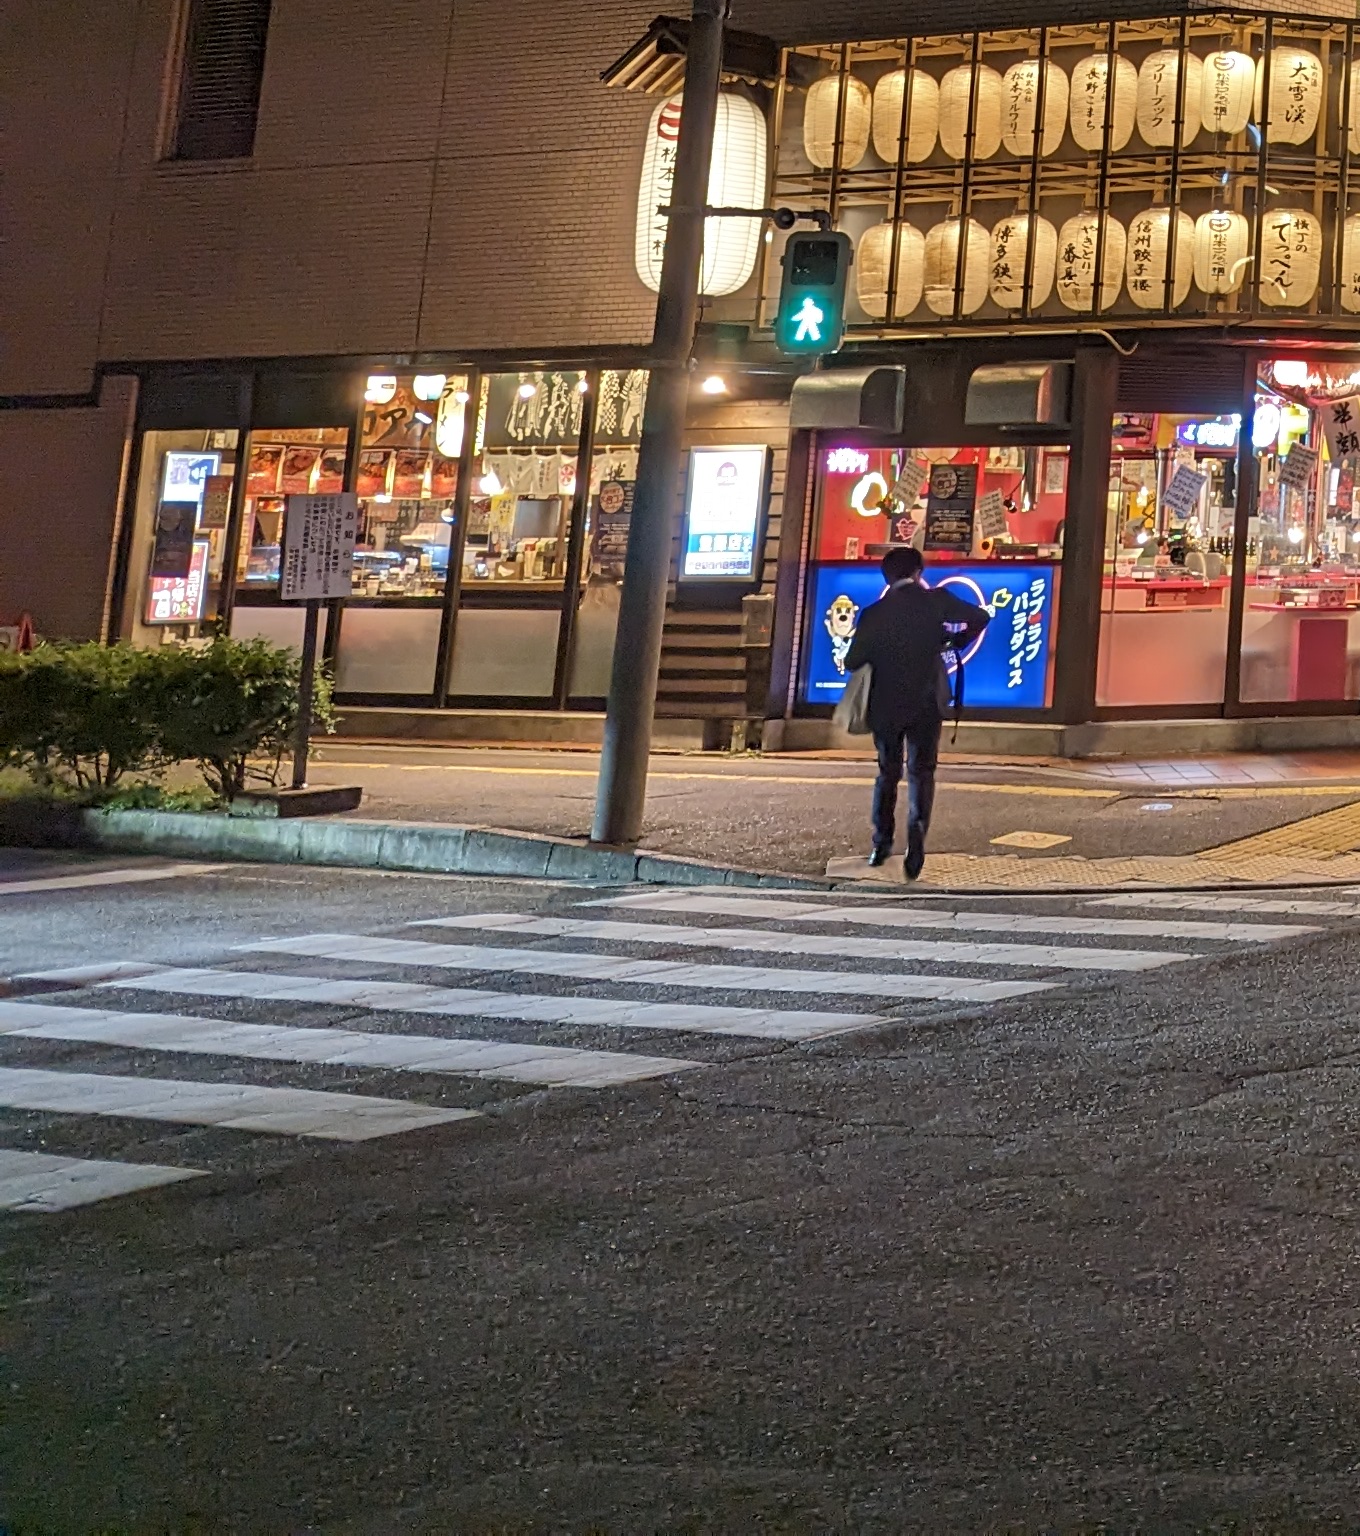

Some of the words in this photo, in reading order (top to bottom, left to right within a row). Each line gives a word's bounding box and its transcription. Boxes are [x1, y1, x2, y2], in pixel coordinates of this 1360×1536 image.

[1008, 70, 1025, 139] 松本ブルワリー
[1085, 67, 1101, 132] 長野こまち
[1151, 64, 1167, 128] フリーブック
[1080, 224, 1099, 275] やきとり
[1269, 222, 1294, 288] てっぺん
[1293, 218, 1310, 254] 横丁の
[341, 511, 355, 578] お知らせ
[1007, 591, 1029, 689] パラダイス
